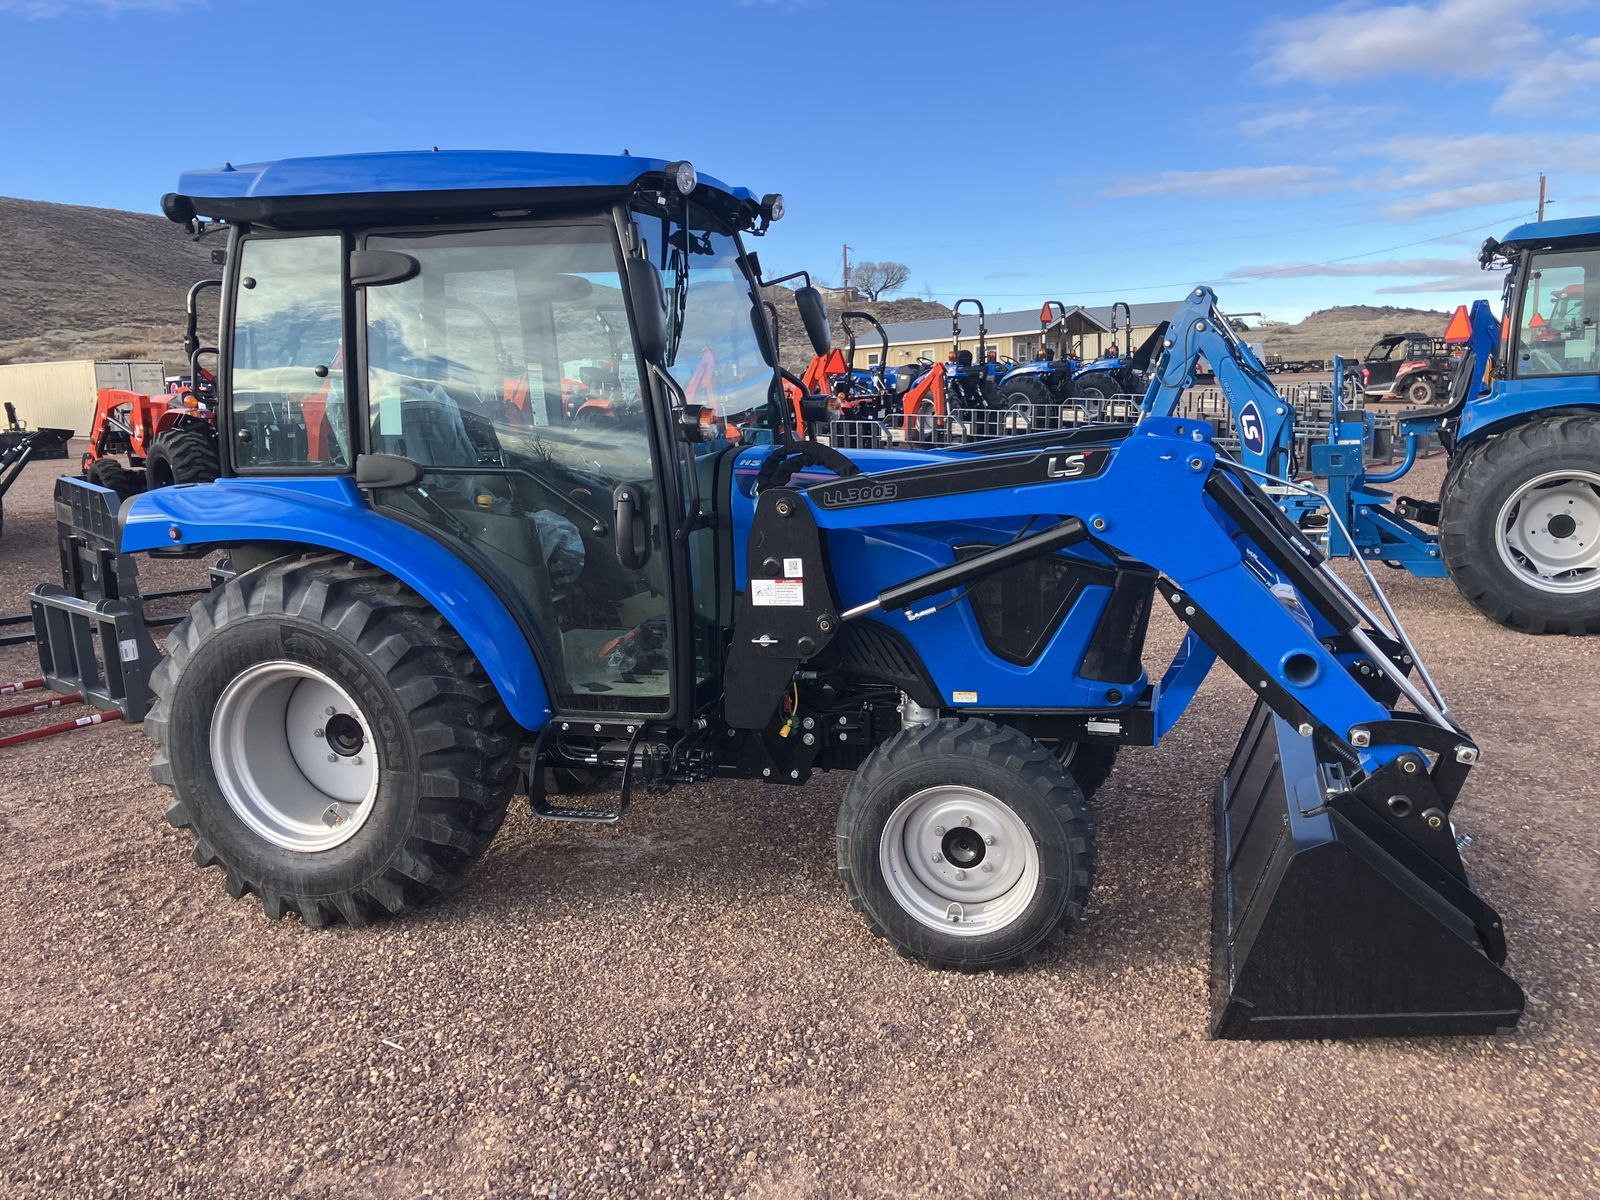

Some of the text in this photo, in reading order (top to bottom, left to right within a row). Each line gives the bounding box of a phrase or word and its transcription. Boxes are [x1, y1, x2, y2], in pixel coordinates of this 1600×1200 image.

[1241, 414, 1260, 441] LS
[1047, 454, 1086, 478] LS
[823, 483, 898, 507] LL3003
[337, 652, 405, 772] TIRON
